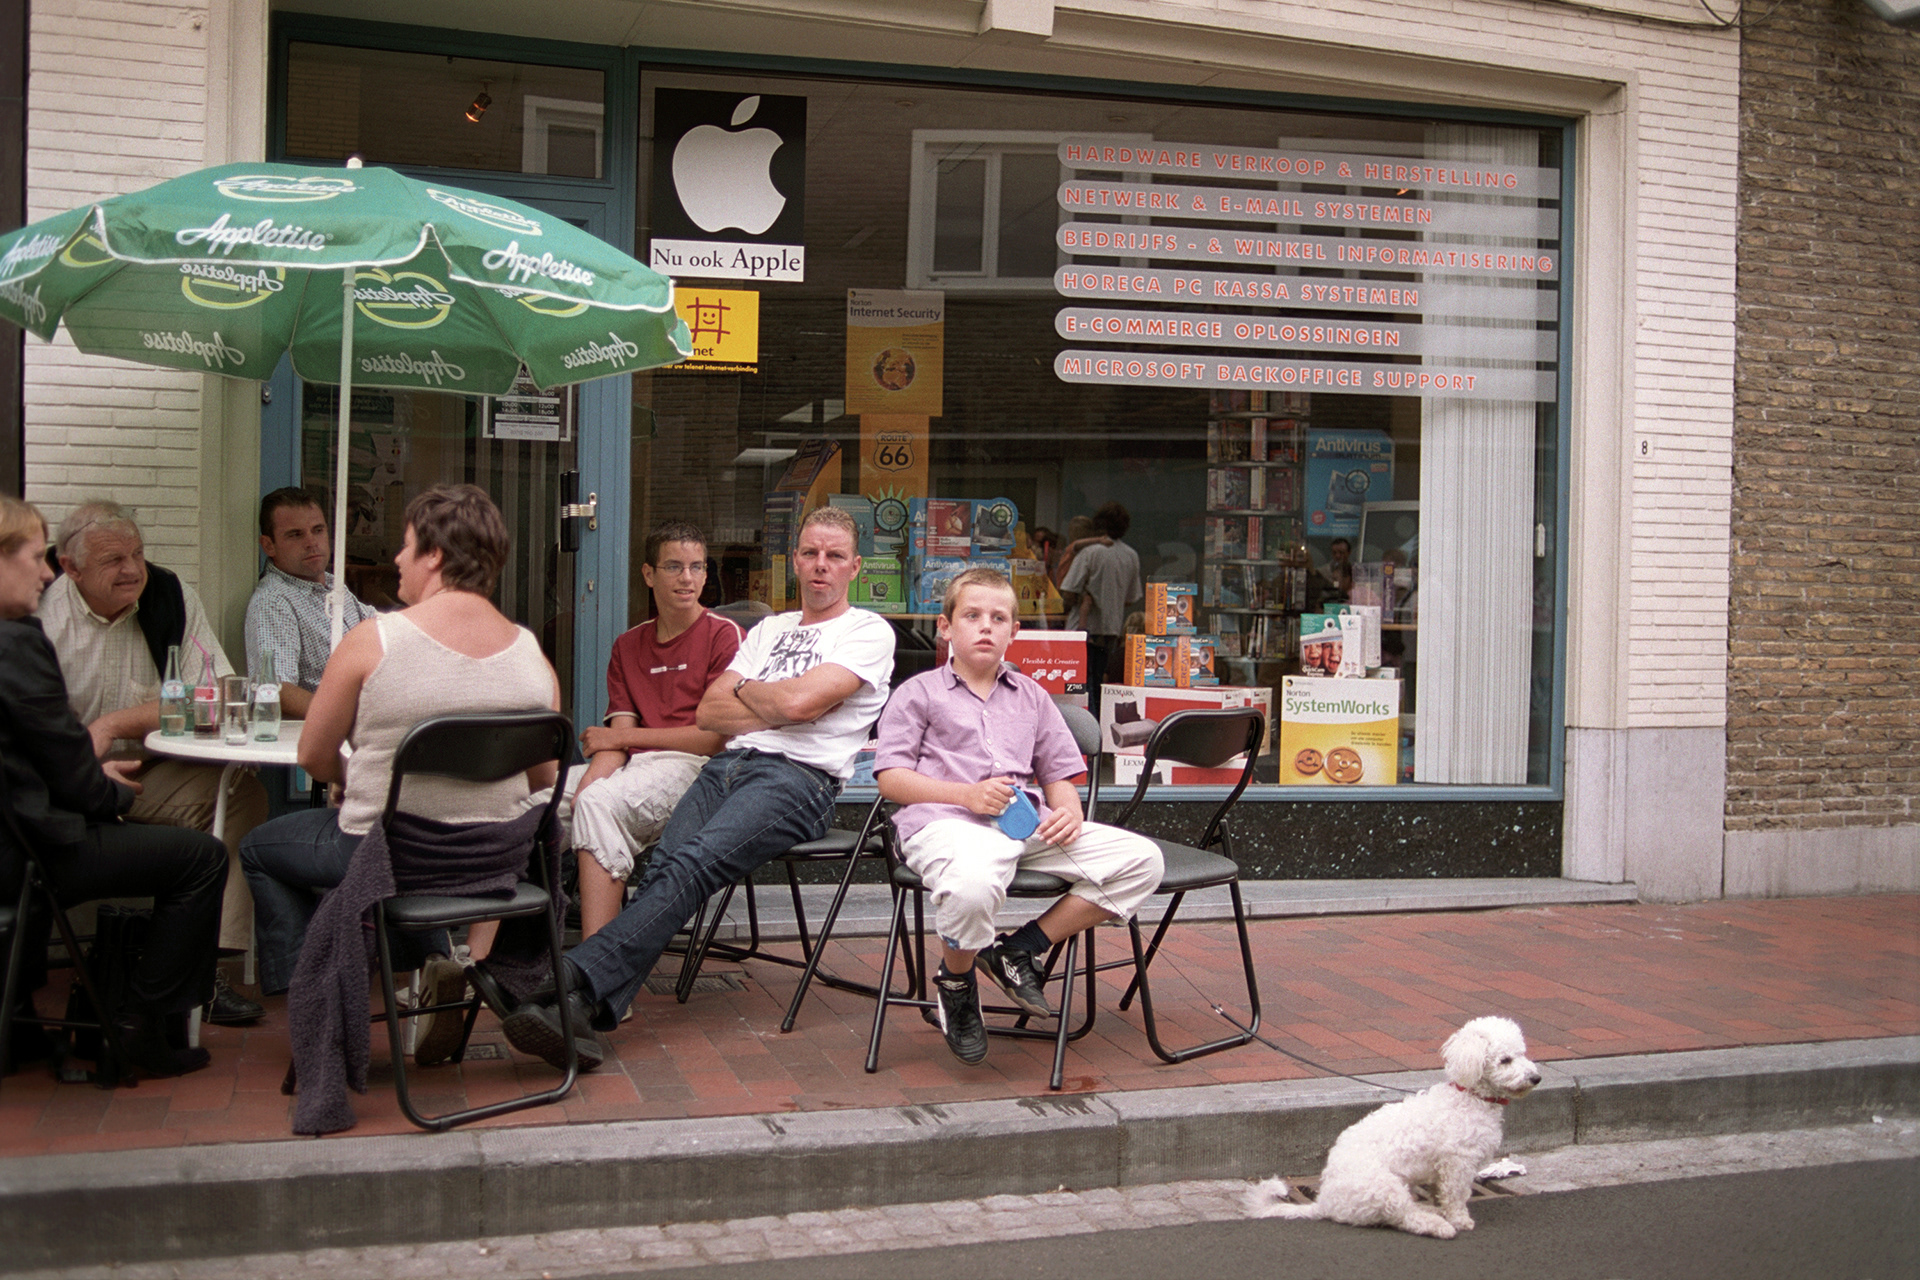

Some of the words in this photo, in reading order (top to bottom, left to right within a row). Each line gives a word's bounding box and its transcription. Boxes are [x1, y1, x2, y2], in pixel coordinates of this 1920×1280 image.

[1066, 145, 1202, 168] HARDWARE
[1213, 152, 1326, 175] VERKOOP
[1338, 162, 1352, 178] &
[1364, 163, 1517, 188] HERSTELLING
[1065, 188, 1180, 210] NETWERK
[1192, 195, 1207, 211] &
[1220, 196, 1304, 216] E-MAIL
[1314, 201, 1432, 223] SYSTEMEN
[175, 213, 327, 255] Appletise
[482, 241, 594, 286] Appletise
[653, 247, 682, 267] Nu
[689, 249, 724, 268] ook
[730, 248, 801, 278] Apple
[1063, 230, 1177, 251] BEDRIJFS
[1208, 238, 1222, 254] &
[1234, 239, 1327, 260] WINKEL
[1338, 245, 1553, 272] INFORMATISERING
[1062, 273, 1162, 294] HORECA
[1174, 278, 1202, 295] PC
[1214, 280, 1290, 300] KASSA
[1300, 284, 1419, 306] SYSTEMEN
[850, 307, 894, 318] Internet
[897, 308, 941, 321] Security
[1065, 317, 1222, 338] E-COMMERCE
[1234, 323, 1400, 346] OPLOSSINGEN
[693, 346, 714, 357] net
[1063, 358, 1206, 380] MICROSOFT
[1217, 364, 1362, 386] BACKOFFICE
[1373, 371, 1477, 391] SUPPORT
[880, 434, 907, 442] ROUTE
[1315, 437, 1381, 453] Antivirus
[1642, 440, 1648, 455] 8
[878, 445, 909, 466] 66
[862, 561, 895, 569] Antivirus
[970, 561, 1005, 569] Antivirus
[1157, 585, 1165, 634] CREATIVE
[1135, 637, 1144, 686] CREATIVE
[1180, 637, 1189, 686] CREATIVE
[1104, 688, 1135, 697] LEXMARK
[1286, 689, 1310, 697] Norton
[1286, 698, 1390, 716] SystemWorks
[1123, 759, 1159, 768] LEXMK
